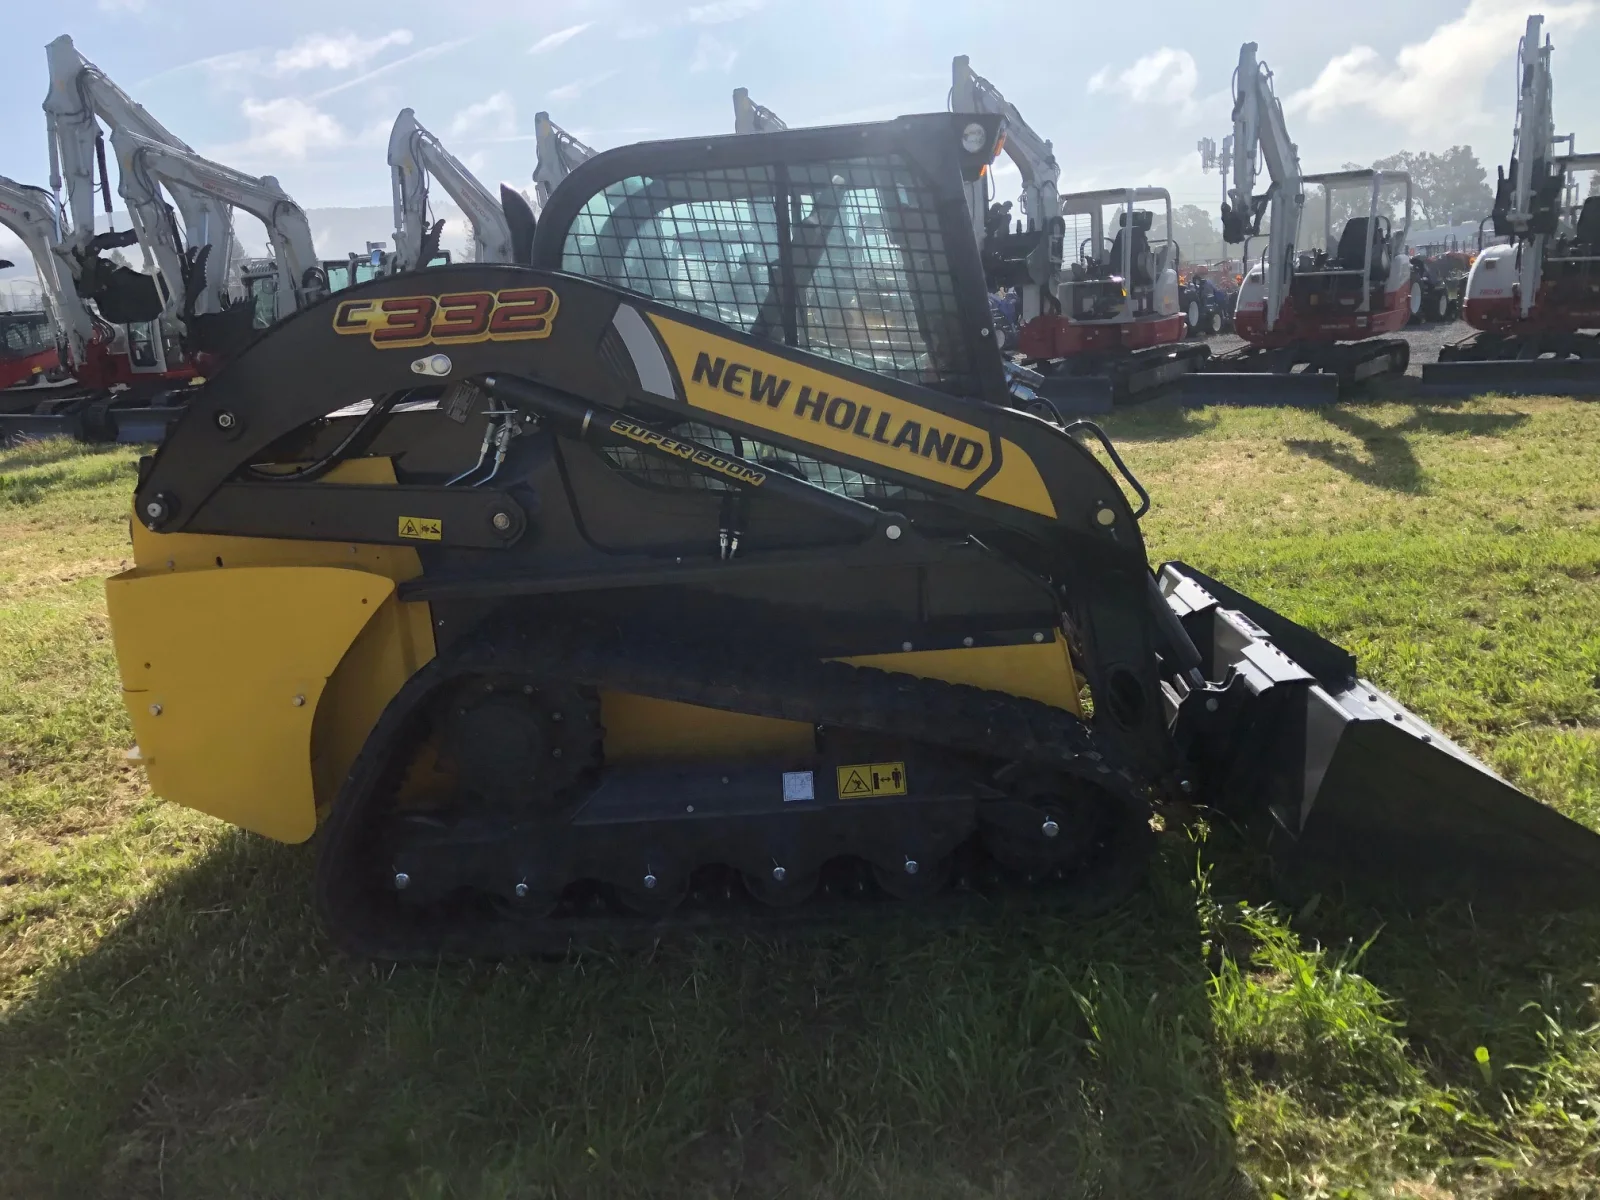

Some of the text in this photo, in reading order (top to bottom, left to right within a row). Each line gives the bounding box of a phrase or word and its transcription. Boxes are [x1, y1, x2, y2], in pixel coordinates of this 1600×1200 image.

[333, 286, 560, 349] C332
[691, 351, 984, 471] NEW HOLLAND
[610, 419, 766, 486] SUPER BOOM
